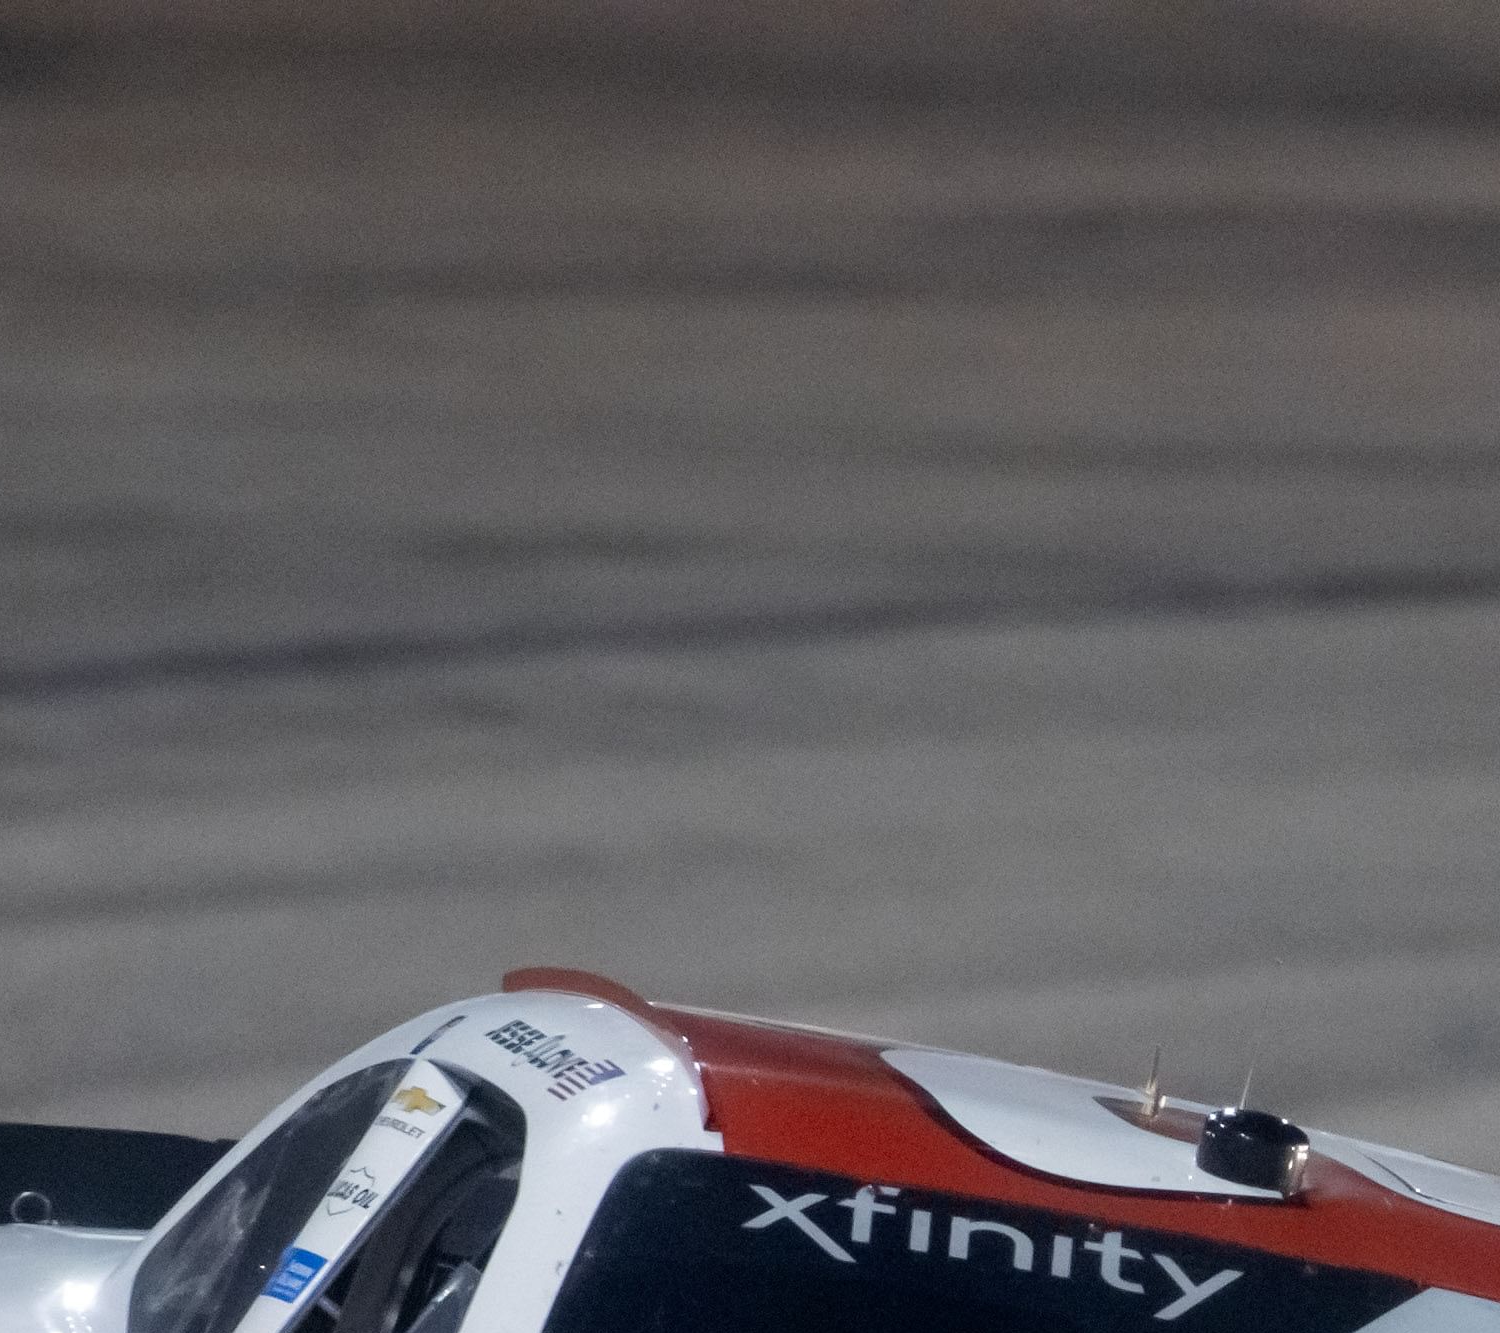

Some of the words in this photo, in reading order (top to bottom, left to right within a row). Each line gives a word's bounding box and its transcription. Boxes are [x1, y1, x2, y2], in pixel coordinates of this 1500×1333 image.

[483, 1019, 547, 1054] JESSE
[373, 1115, 426, 1139] ROLET
[352, 1188, 379, 1209] OIL
[741, 1183, 1244, 1322] xfinity
